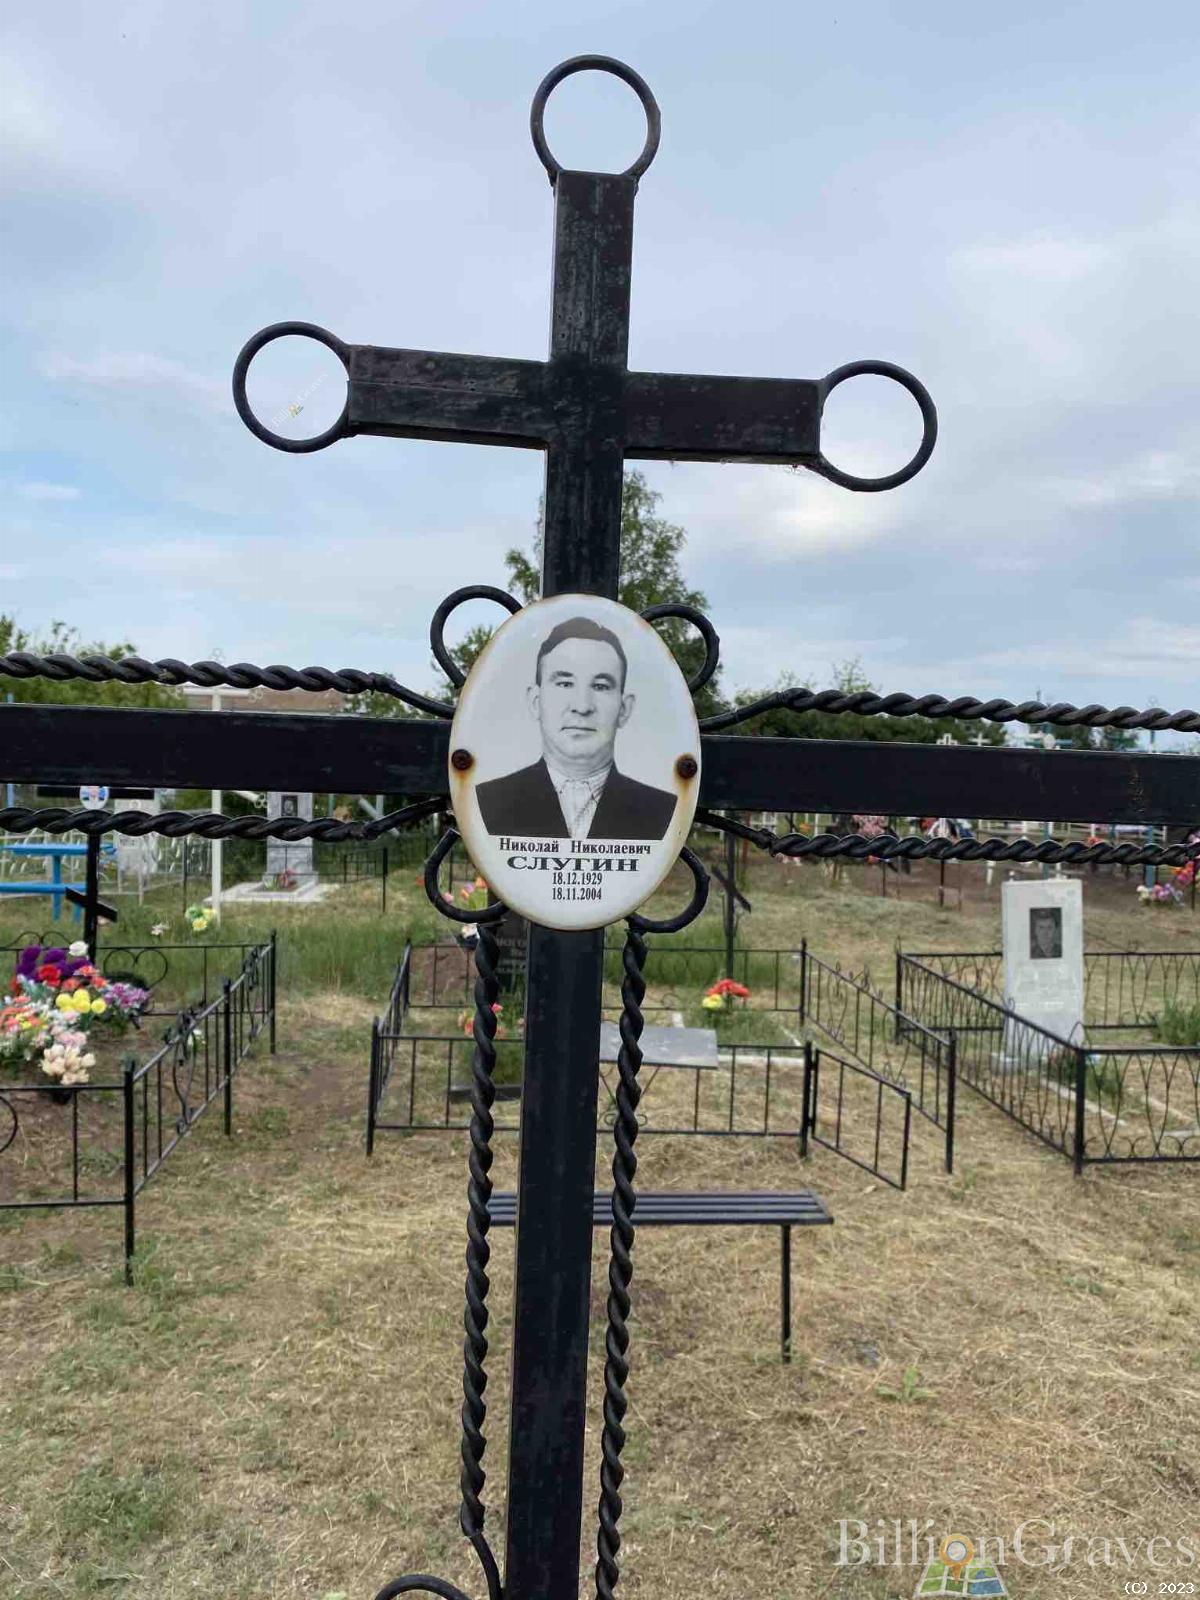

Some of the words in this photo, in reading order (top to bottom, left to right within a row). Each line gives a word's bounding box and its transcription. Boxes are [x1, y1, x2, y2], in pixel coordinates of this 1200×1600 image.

[500, 837, 559, 853] Николай
[571, 840, 651, 855] Николаевич
[507, 856, 640, 872] СЛУГИН
[552, 872, 603, 885] 18.12.1929
[552, 887, 602, 900] 18.11.2004
